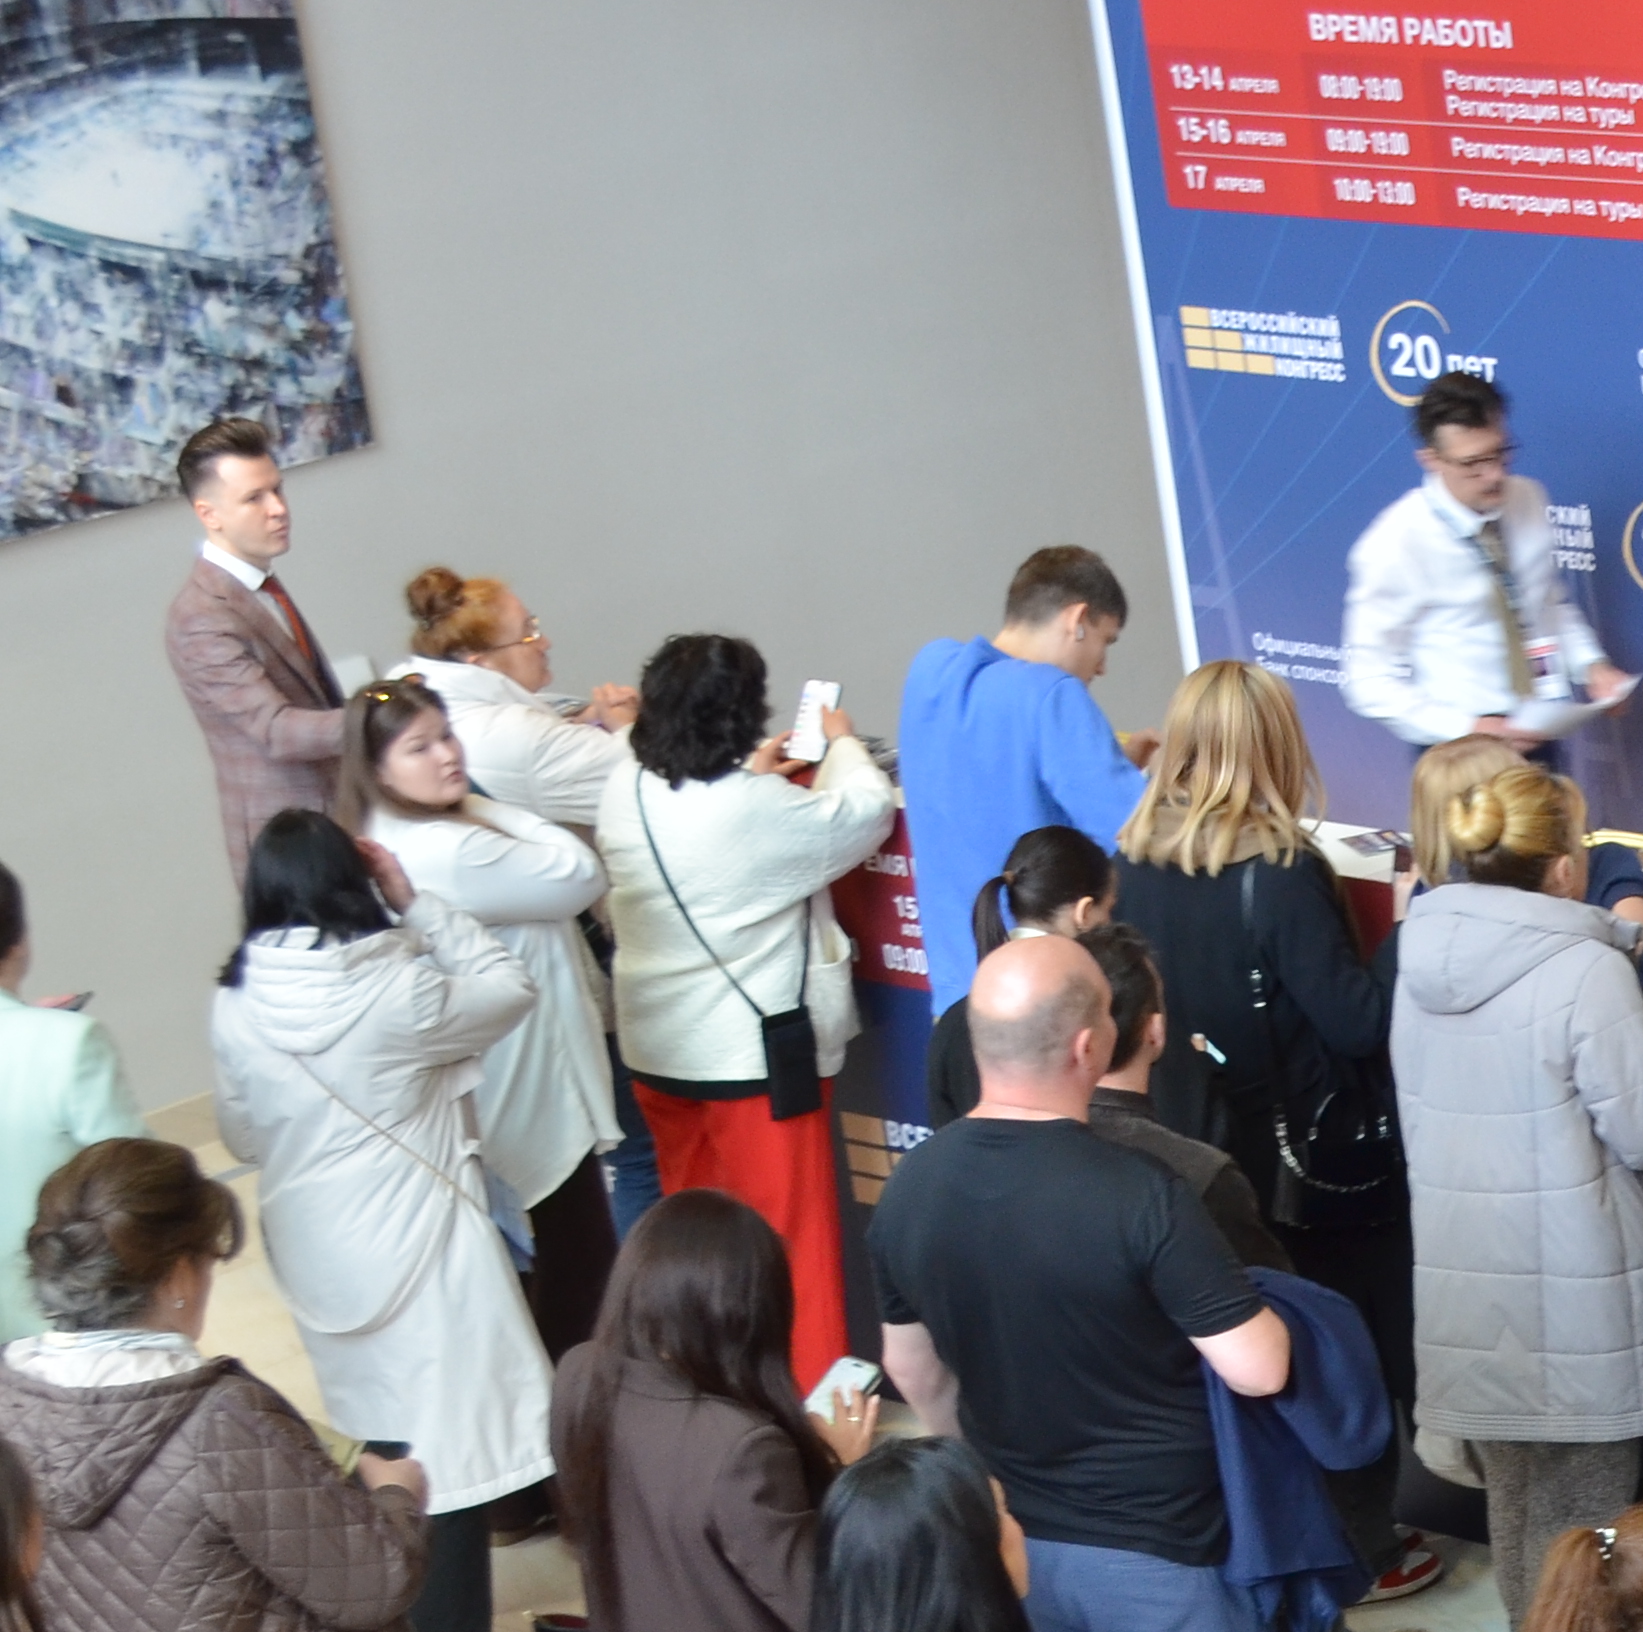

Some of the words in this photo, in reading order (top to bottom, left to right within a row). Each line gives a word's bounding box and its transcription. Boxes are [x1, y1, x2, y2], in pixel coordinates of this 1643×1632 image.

[1308, 12, 1400, 45] ВРЕМЯ
[1403, 17, 1514, 49] РАБОТЫ
[1169, 63, 1225, 91] 13-14
[1228, 76, 1280, 94] АПРЕЛЯ
[1442, 69, 1558, 98] Регистрация
[1560, 80, 1584, 97] на
[1446, 94, 1561, 124] Регистрация
[1563, 106, 1588, 123] на
[1588, 106, 1636, 129] туры
[1176, 116, 1233, 144] 15-16
[1235, 129, 1287, 147] АПРЕЛЯ
[1451, 136, 1566, 166] Регистрация
[1567, 148, 1592, 166] на
[1183, 165, 1208, 190] 17
[1213, 176, 1266, 193] АПРЕЛЯ
[1456, 186, 1572, 217] Регистрация
[1573, 198, 1598, 218] на
[1209, 308, 1342, 338] ВСЕРОССИЙСКИЙ
[1243, 333, 1344, 361] ЖИЛИЩНЫЙ
[1388, 332, 1442, 380] 20
[1275, 358, 1347, 384] КОНГРЕСС
